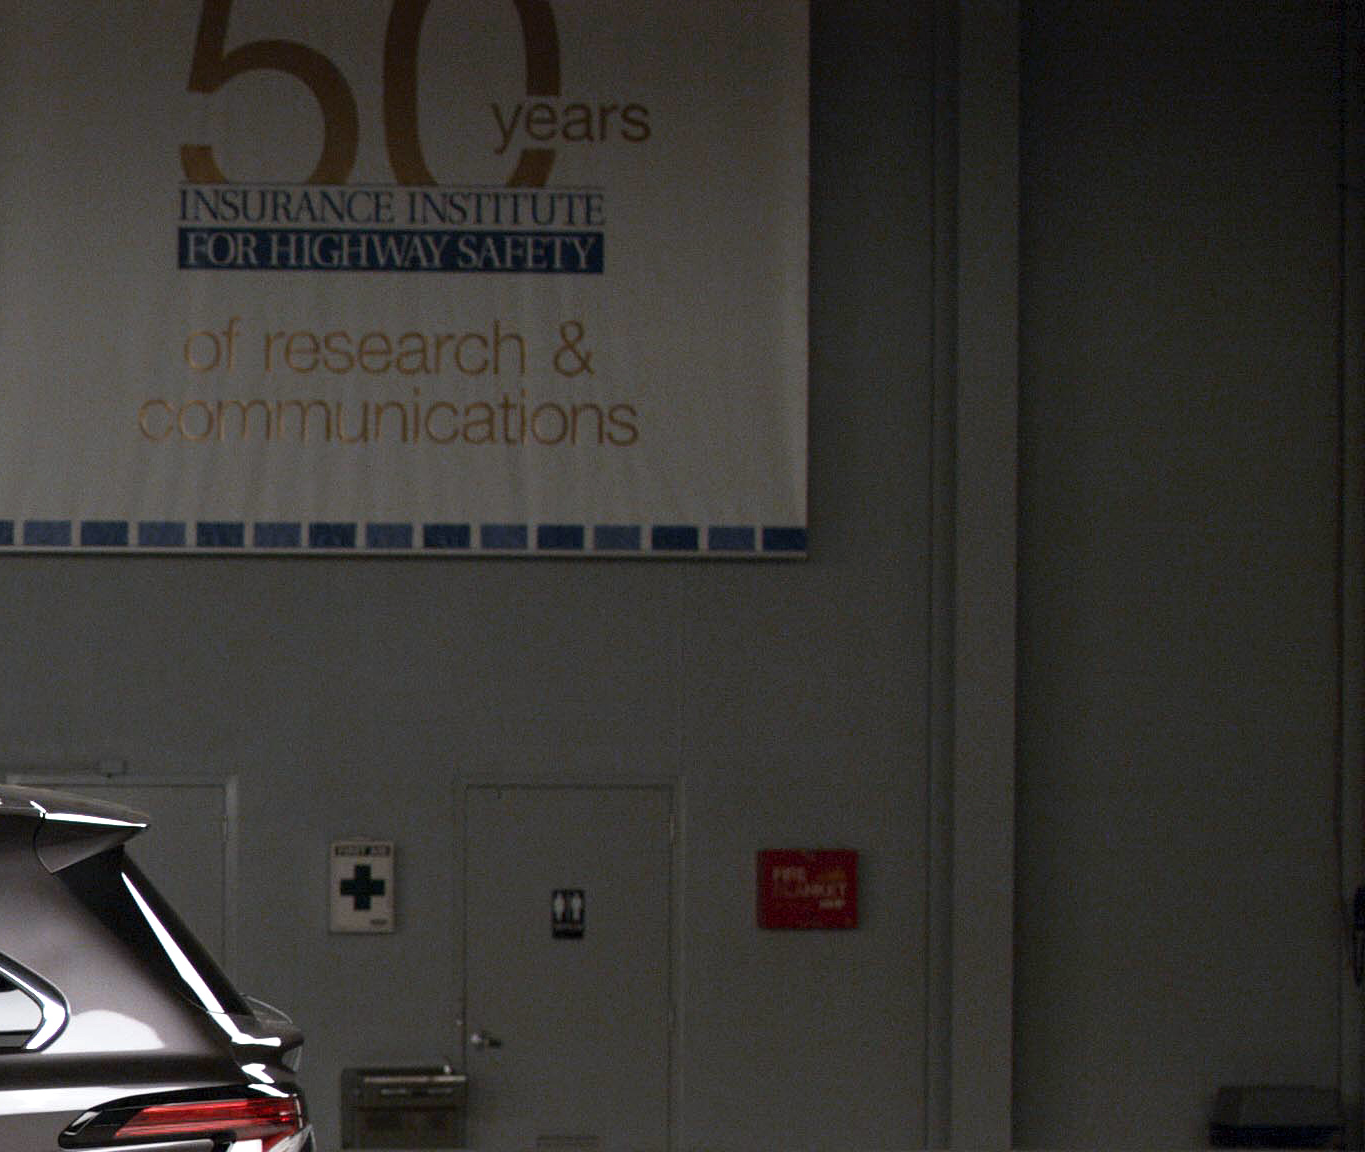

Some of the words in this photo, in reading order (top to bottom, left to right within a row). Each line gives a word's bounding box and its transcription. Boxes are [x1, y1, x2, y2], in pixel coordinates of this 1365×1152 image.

[180, 0, 561, 185] 50
[490, 103, 652, 154] years
[179, 188, 395, 225] INSURANCE
[408, 190, 605, 226] INSTITUTE
[186, 231, 259, 268] FOR
[269, 232, 448, 269] HIGHWAY
[456, 234, 595, 270] SAFETY
[183, 315, 242, 374] of
[262, 319, 528, 377] research
[551, 319, 596, 377] &
[136, 386, 640, 447] communications
